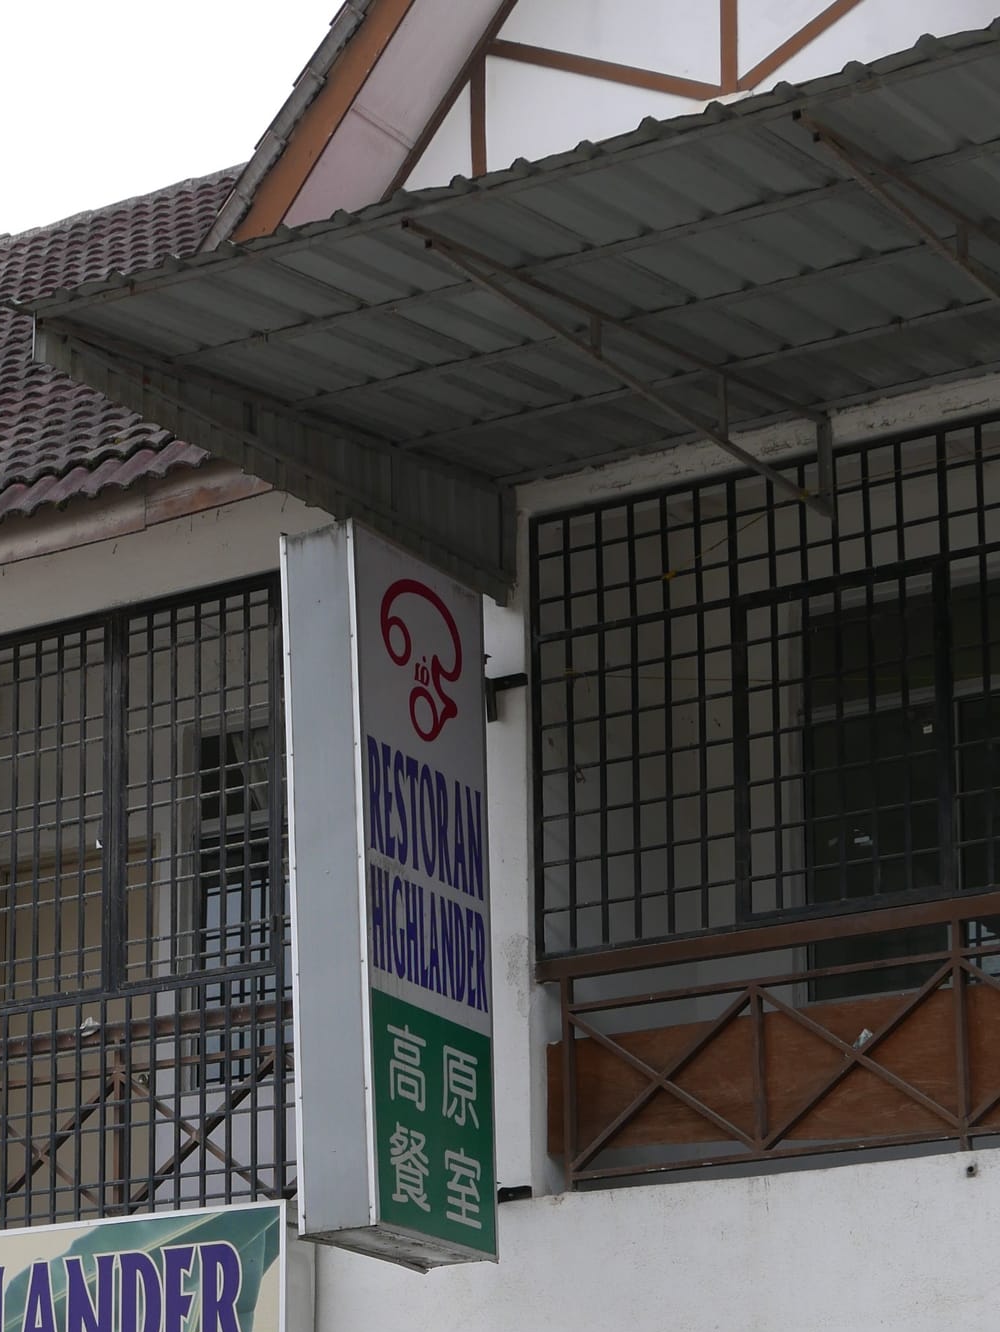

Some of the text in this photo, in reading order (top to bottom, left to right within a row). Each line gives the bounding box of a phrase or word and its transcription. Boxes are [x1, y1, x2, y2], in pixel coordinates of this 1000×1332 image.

[366, 733, 484, 901] RESTORAN
[370, 864, 489, 1014] HIGHLANDER
[386, 1023, 480, 1130] 高原
[389, 1121, 483, 1230] 餐室
